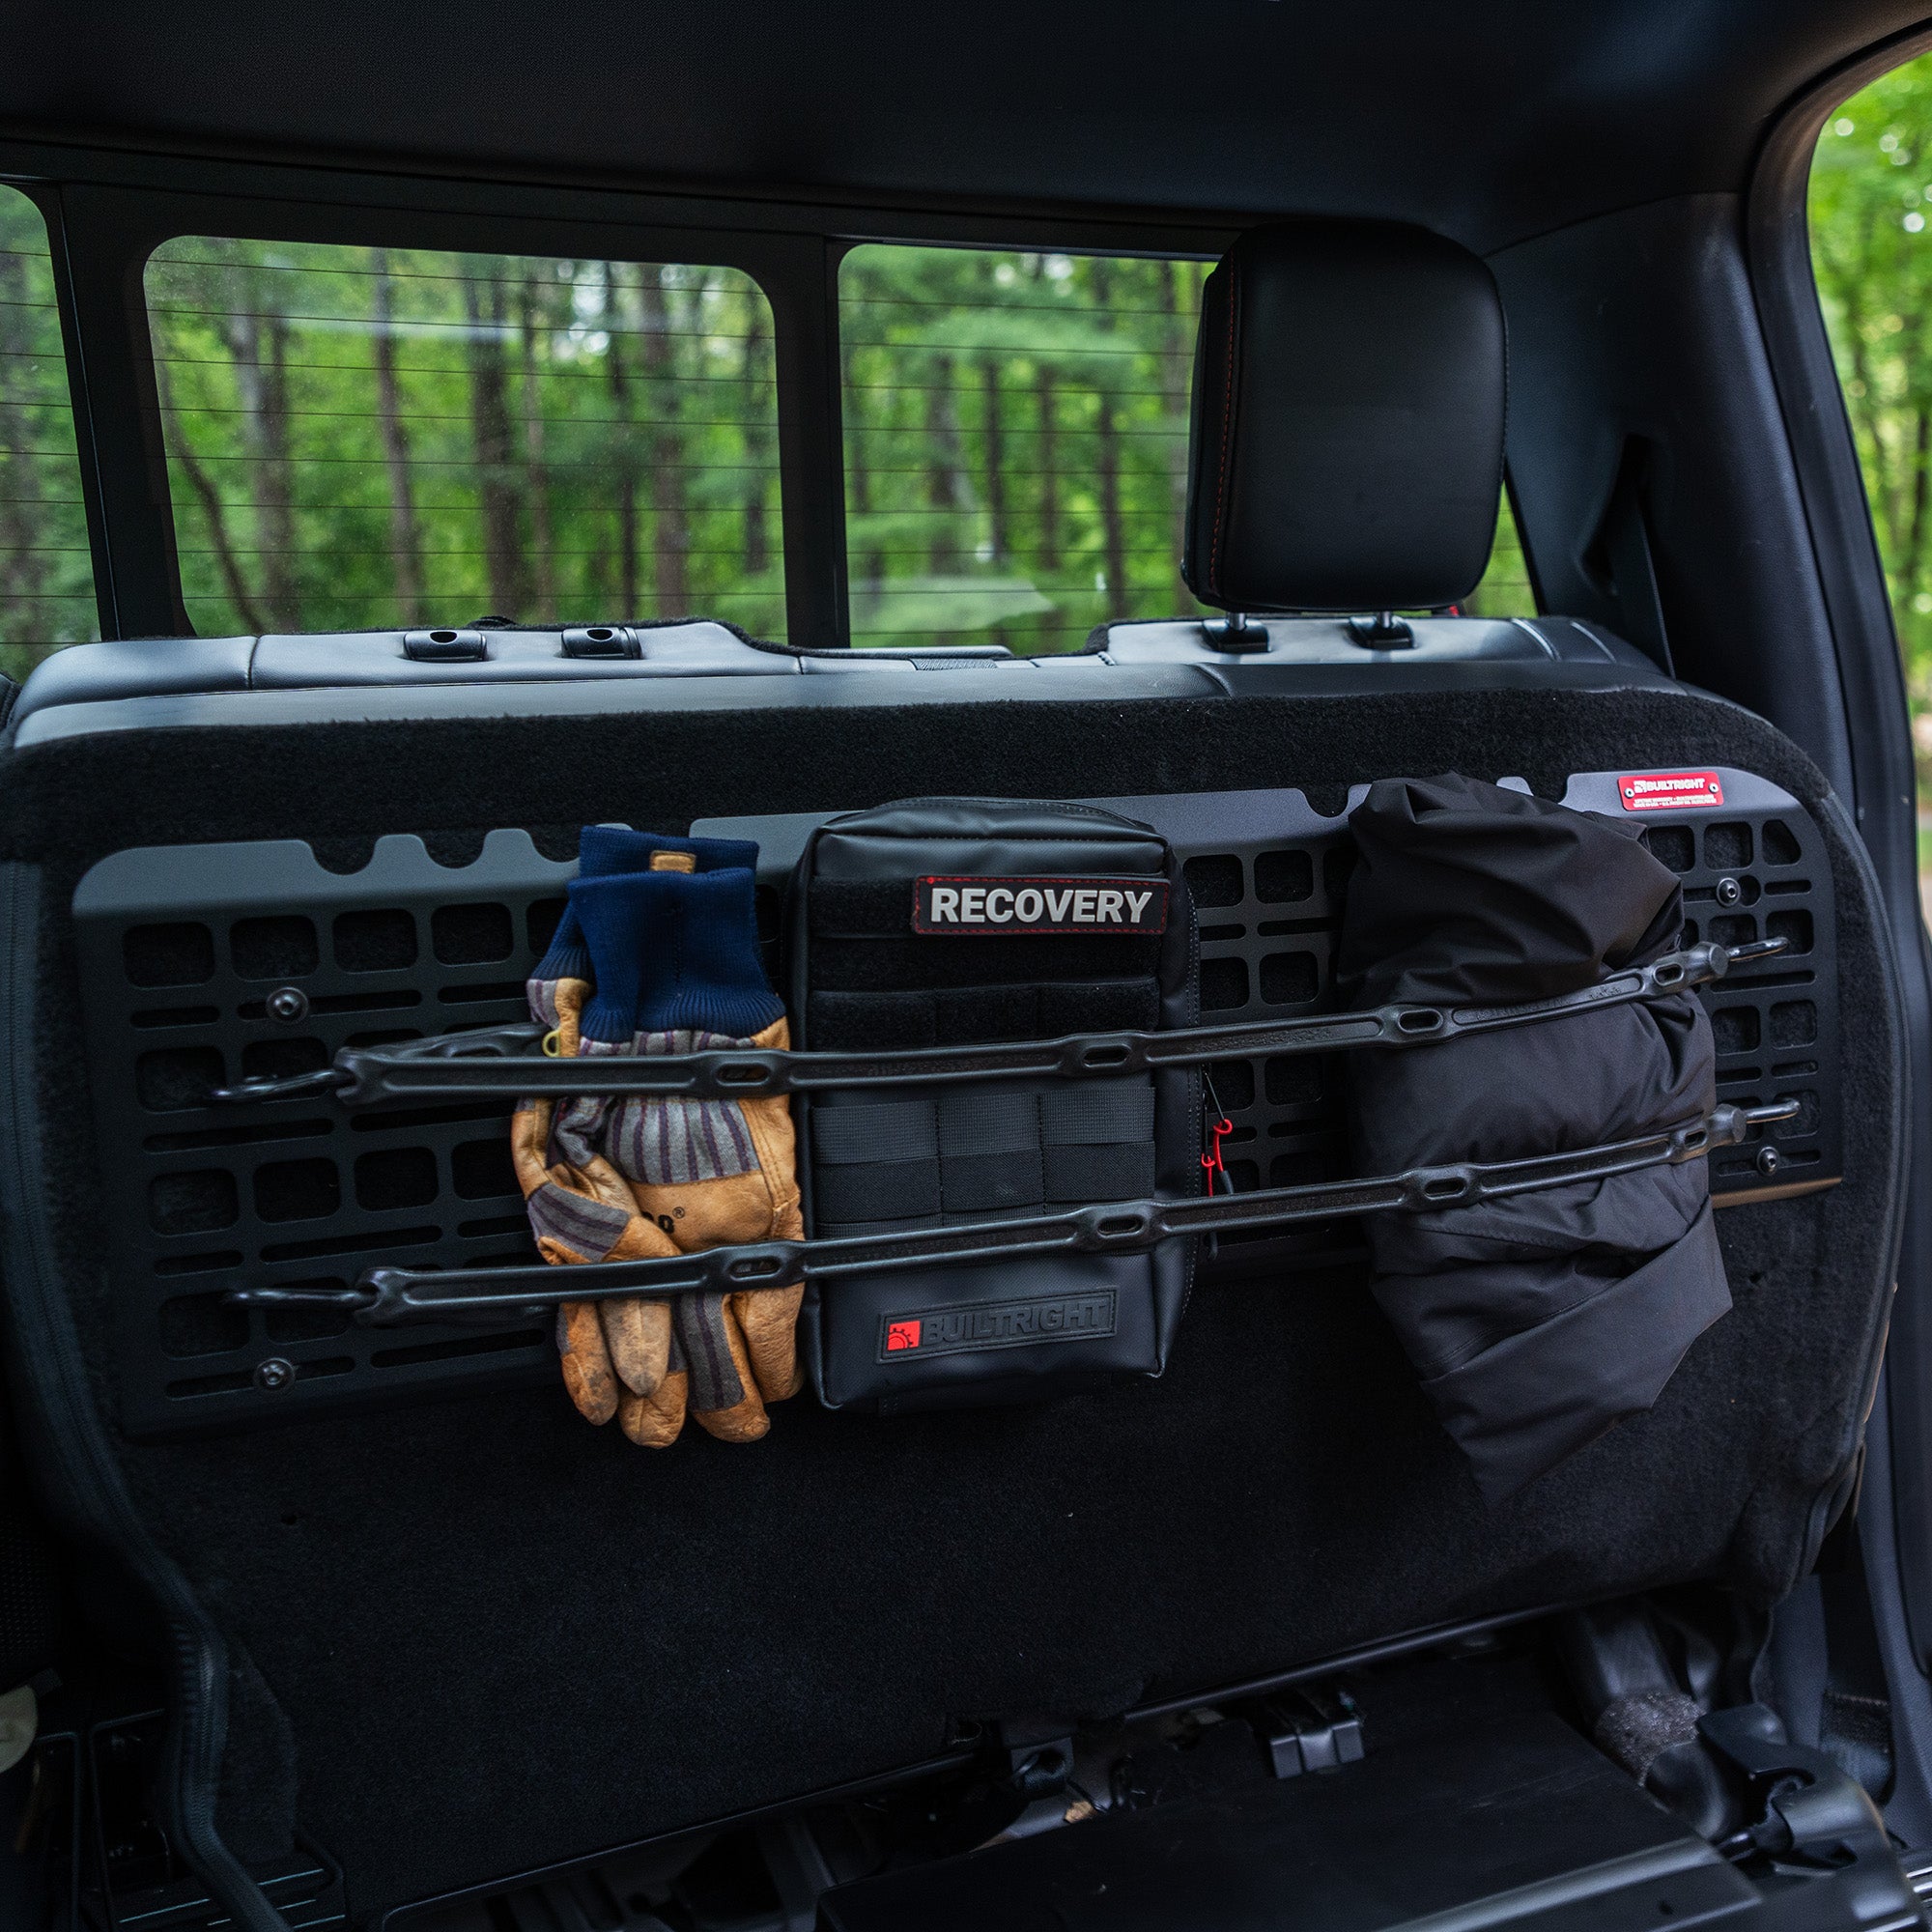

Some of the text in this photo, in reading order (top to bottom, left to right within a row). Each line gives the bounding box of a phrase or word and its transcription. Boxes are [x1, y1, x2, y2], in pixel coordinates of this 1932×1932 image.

[1647, 778, 1704, 791] BUILTRIGHT
[931, 887, 1152, 923] RECOVERY
[923, 1300, 1108, 1344] BUILTRIGHT
